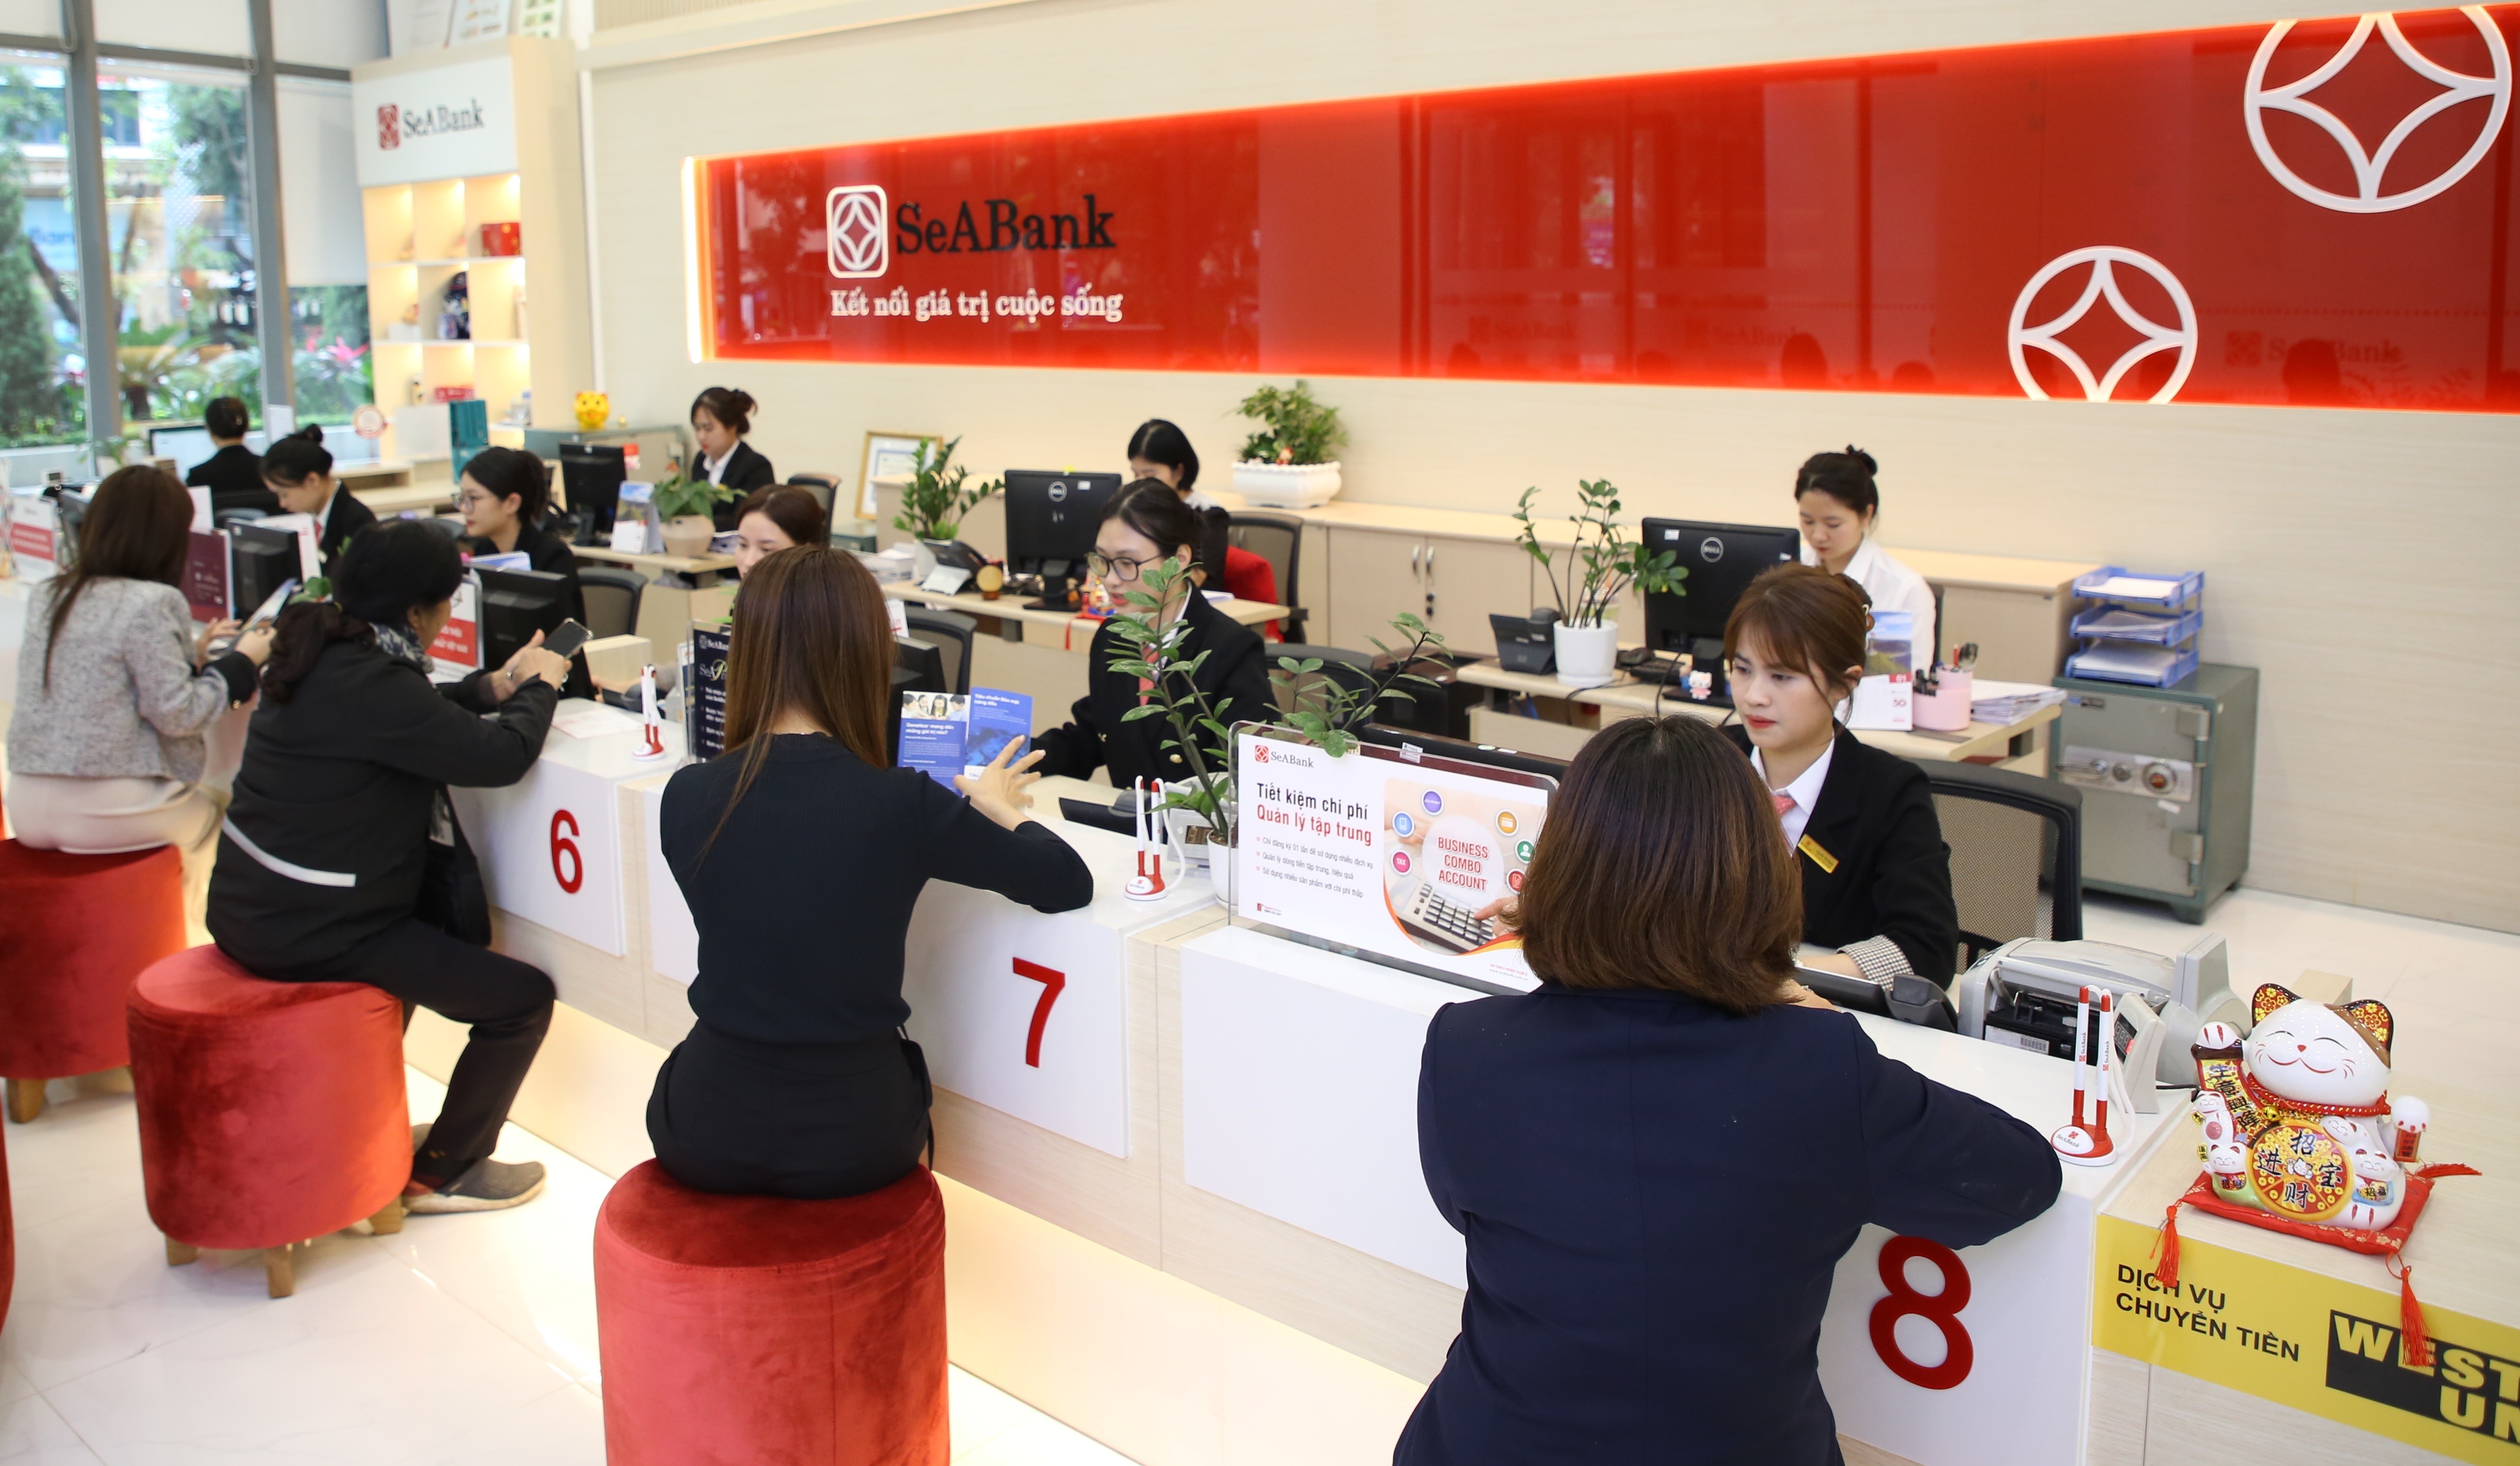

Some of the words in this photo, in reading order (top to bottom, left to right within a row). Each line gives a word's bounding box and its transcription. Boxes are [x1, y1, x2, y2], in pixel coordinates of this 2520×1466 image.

[403, 97, 485, 138] SeABank
[896, 193, 1116, 254] SeABank
[830, 285, 869, 316] Kết
[873, 285, 910, 316] nối
[915, 288, 952, 322] giá
[958, 289, 990, 323] trị
[995, 288, 1055, 323] cuộc
[1060, 282, 1124, 323] sống
[1895, 673, 1907, 682] 01
[1271, 752, 1314, 768] SeABank
[1257, 782, 1281, 802] Tiết
[1286, 789, 1316, 810] kiệm
[1322, 797, 1341, 814] chi
[1348, 803, 1369, 820] phí
[1257, 804, 1289, 825] Quản
[1295, 813, 1306, 832] lý
[1311, 817, 1331, 837] tập
[1337, 822, 1372, 847] trung
[551, 809, 583, 893] 6
[1396, 857, 1406, 866] TAX
[1438, 836, 1489, 858] BUSINESS
[1444, 854, 1481, 874] COMBO
[1438, 870, 1487, 891] ACCOUNT
[1013, 956, 1065, 1068] 7
[2056, 1133, 2081, 1149] SeABank
[1869, 1236, 1974, 1390] 8
[2189, 1283, 2226, 1314] VỤ
[2116, 1293, 2227, 1340] CHUYỂN
[2236, 1326, 2300, 1362] TIỀN
